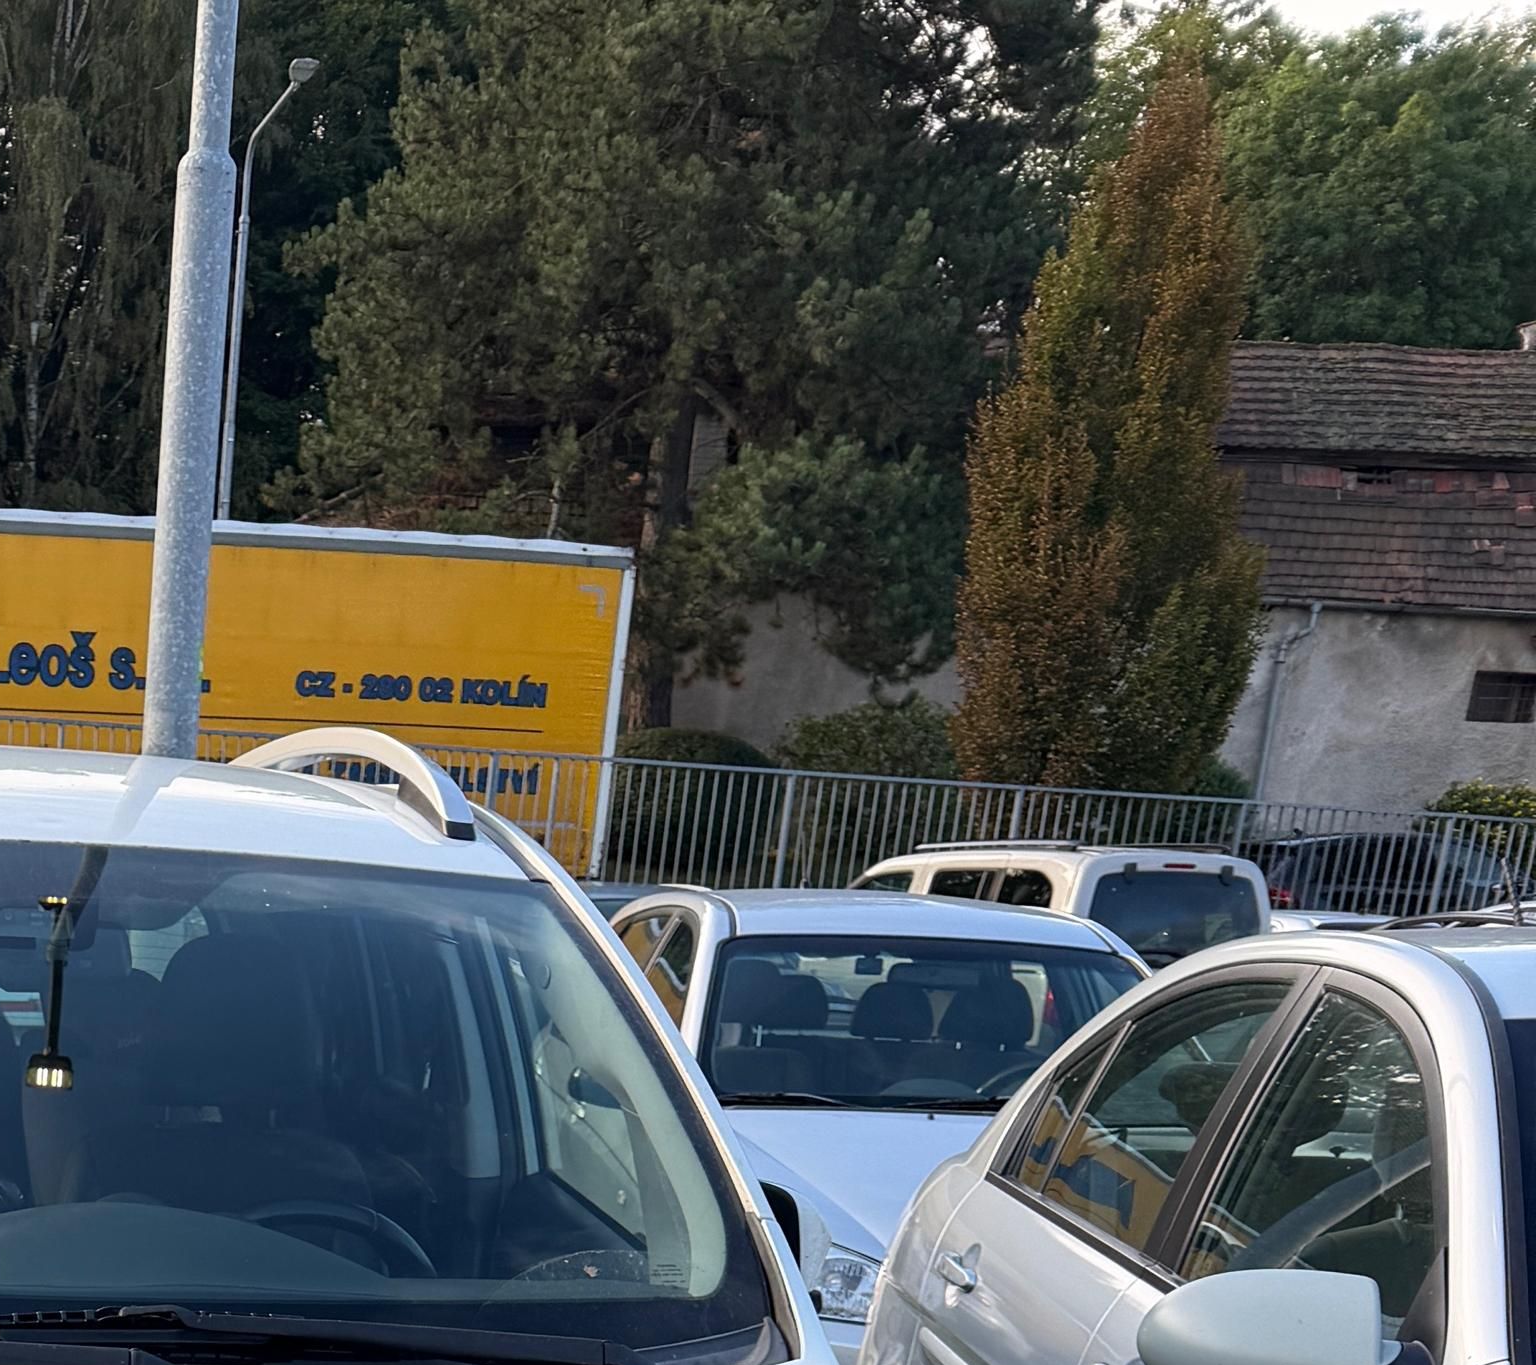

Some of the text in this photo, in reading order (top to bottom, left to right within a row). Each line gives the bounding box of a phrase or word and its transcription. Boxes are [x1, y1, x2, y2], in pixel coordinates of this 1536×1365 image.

[295, 670, 336, 698] CZ
[418, 676, 455, 704] 02
[460, 673, 548, 708] KOLÍN
